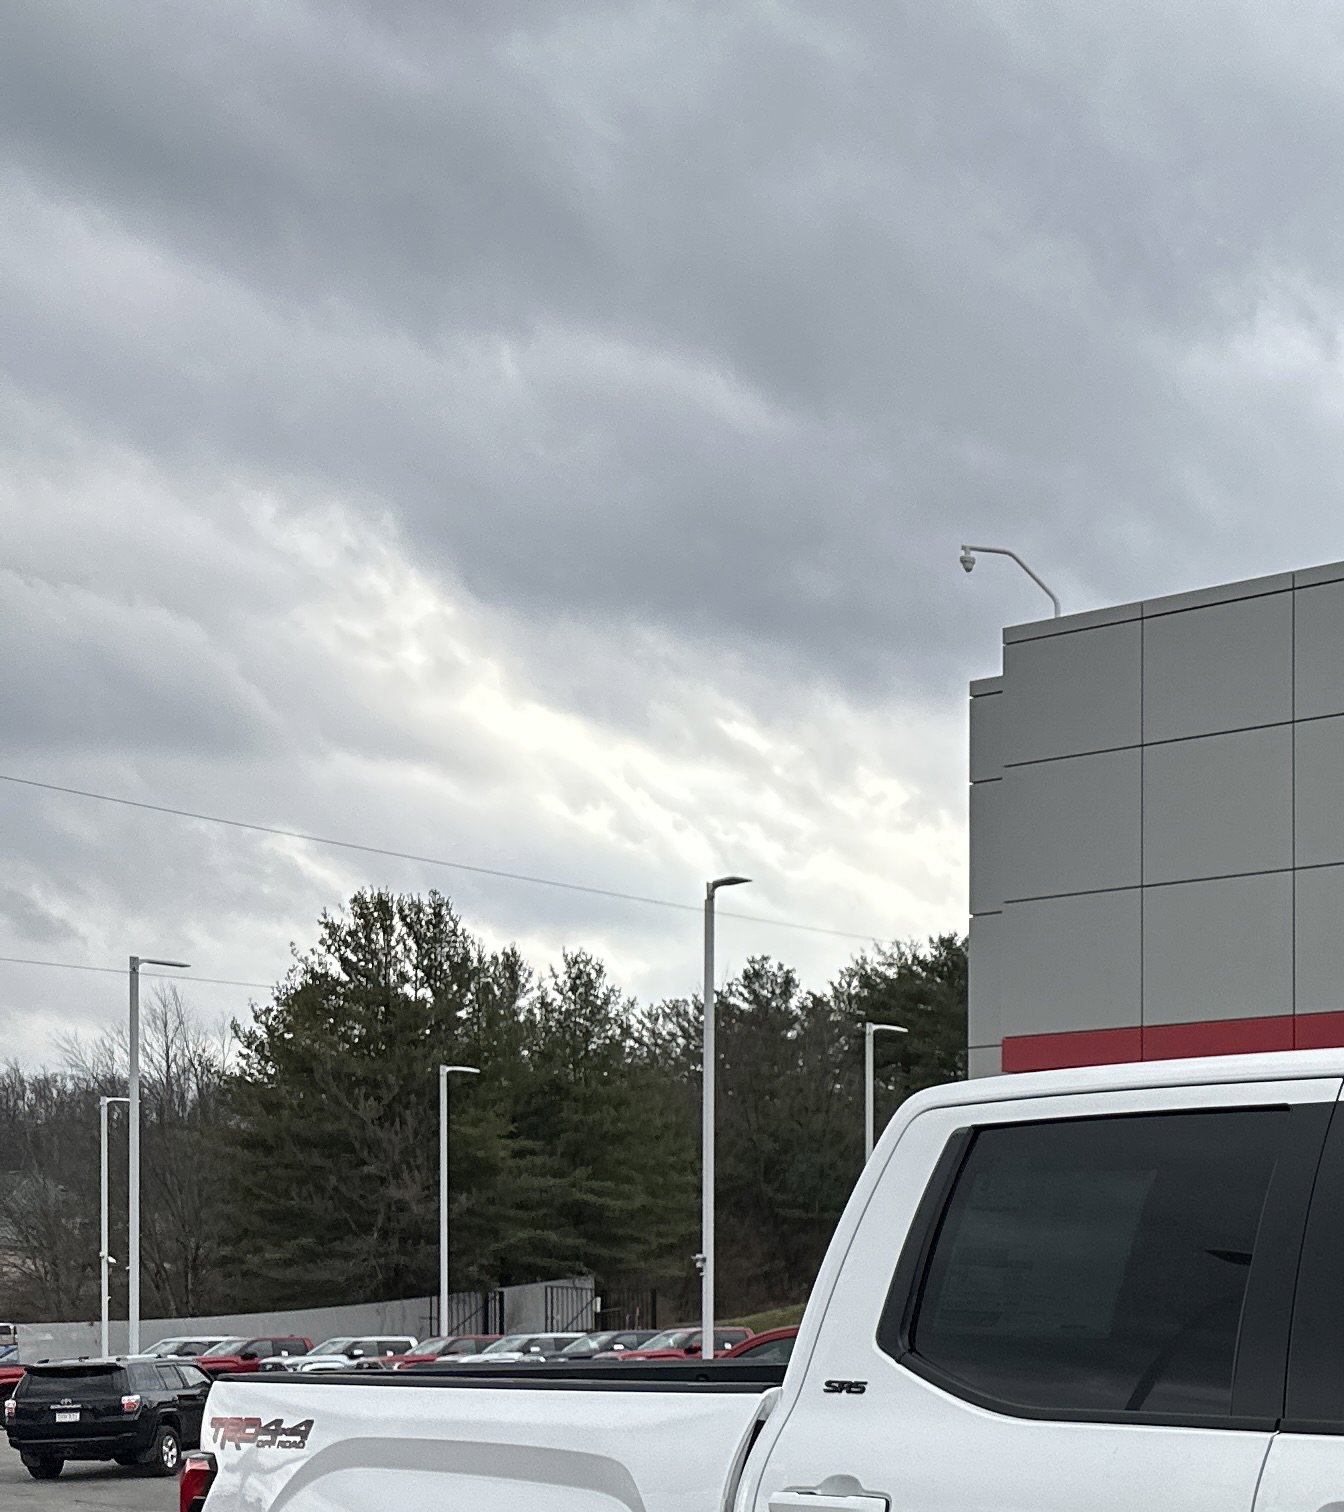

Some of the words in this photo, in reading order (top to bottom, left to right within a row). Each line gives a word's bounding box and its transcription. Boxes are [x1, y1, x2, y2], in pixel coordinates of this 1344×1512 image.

[823, 1380, 868, 1395] SR5
[210, 1417, 261, 1451] TRD
[277, 1440, 306, 1449] ROAD
